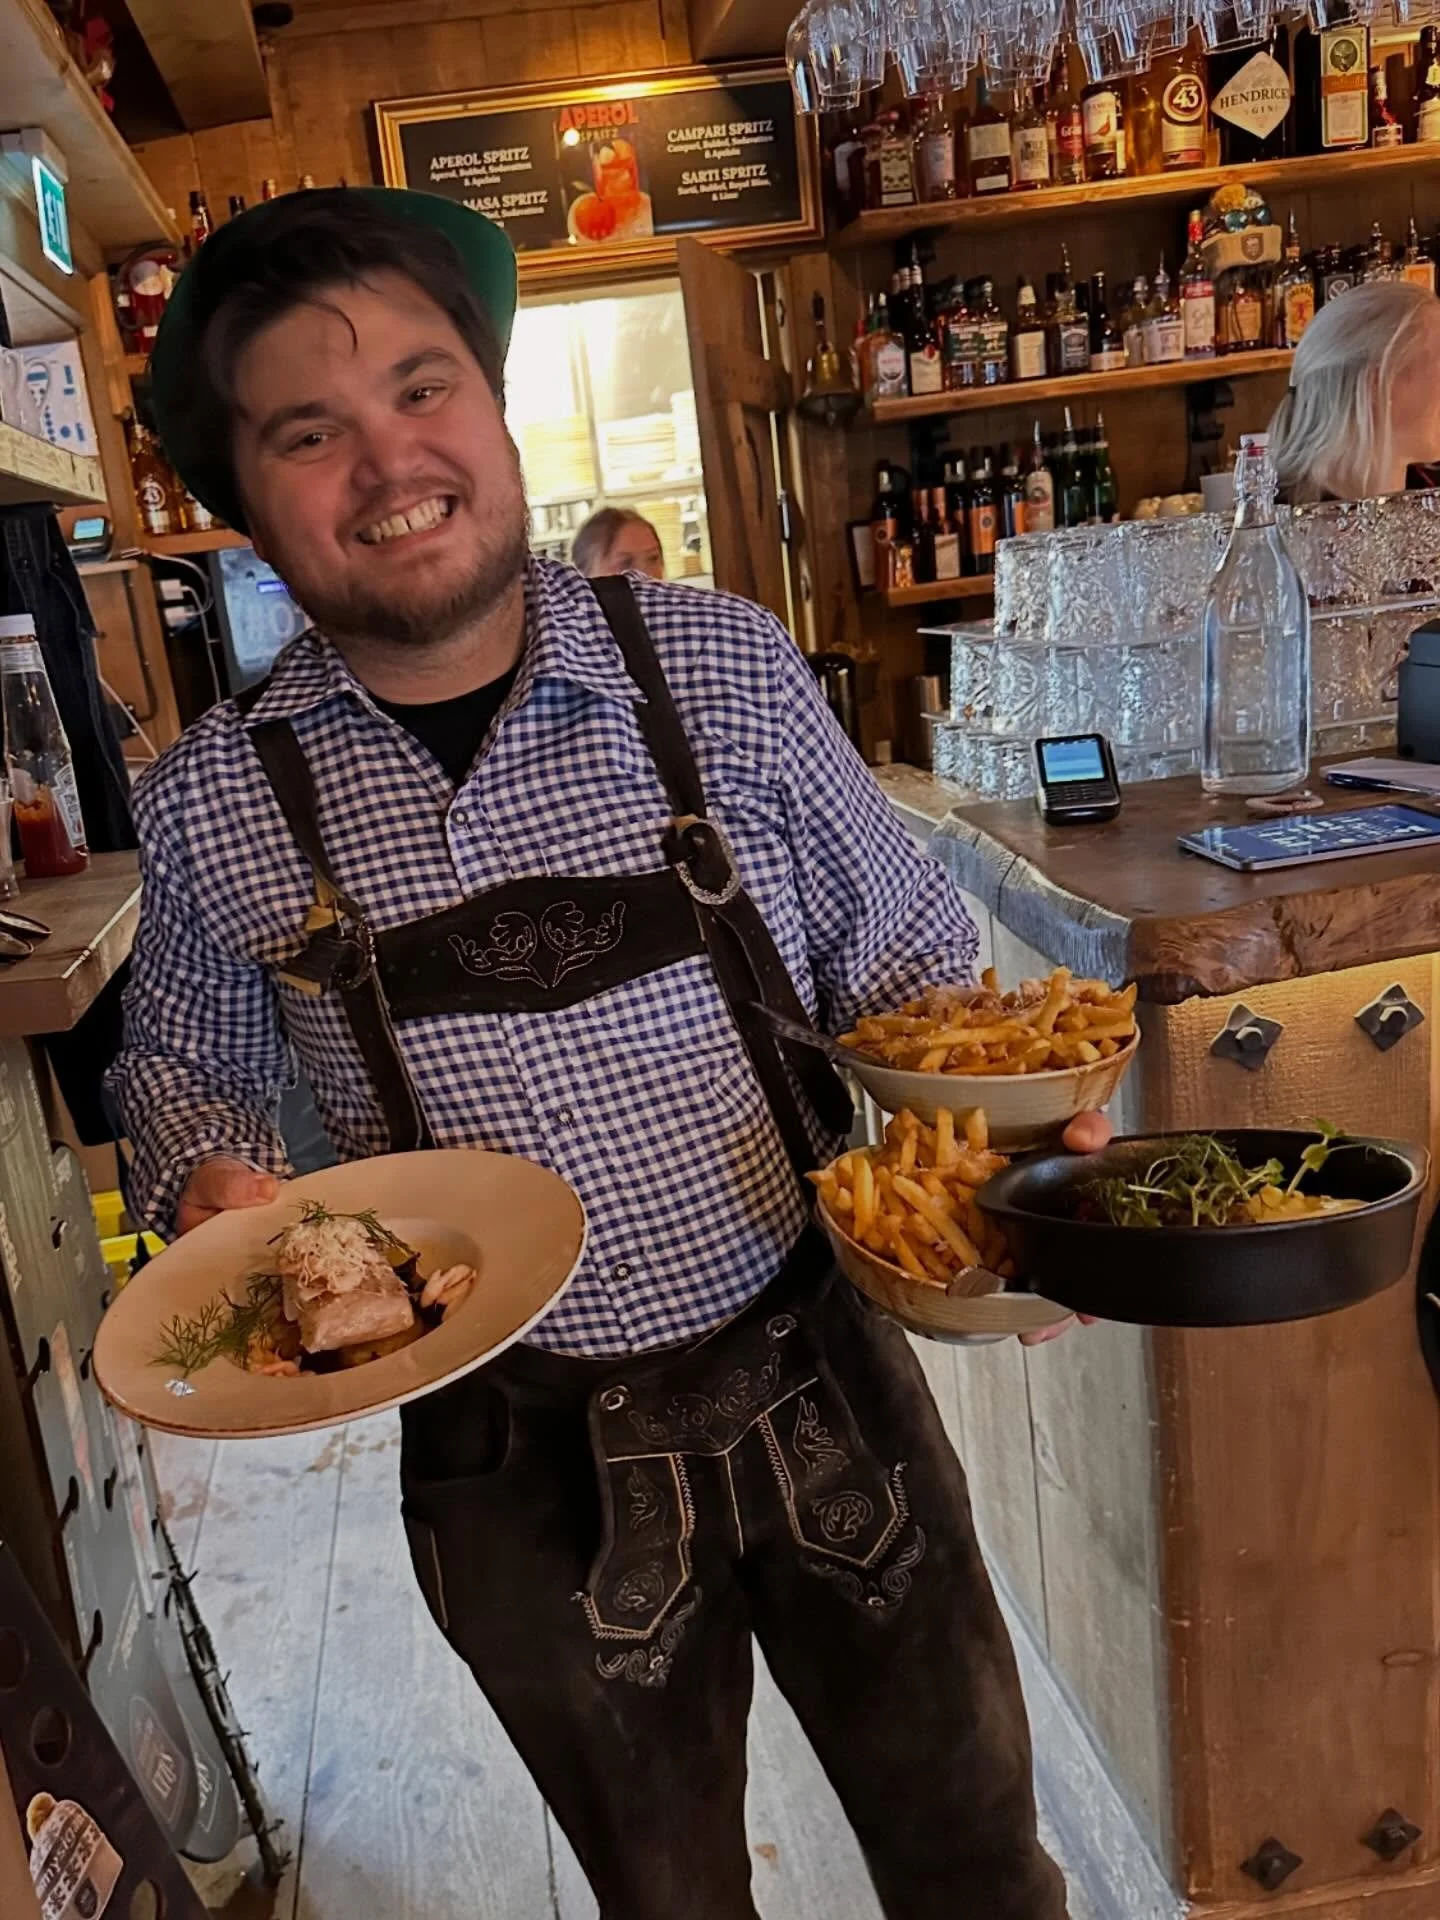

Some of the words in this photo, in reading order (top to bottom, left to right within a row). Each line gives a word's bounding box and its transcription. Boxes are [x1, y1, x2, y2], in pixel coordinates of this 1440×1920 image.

[1172, 85, 1199, 109] 43
[559, 100, 639, 133] APEROL
[667, 124, 727, 143] CAMPARI
[728, 119, 773, 136] SPRITZ
[430, 153, 482, 170] APEROL
[483, 146, 530, 164] SPRITZ
[681, 168, 720, 185] SARTI
[722, 164, 767, 180] SPRITZ
[502, 190, 548, 207] SPRITZ
